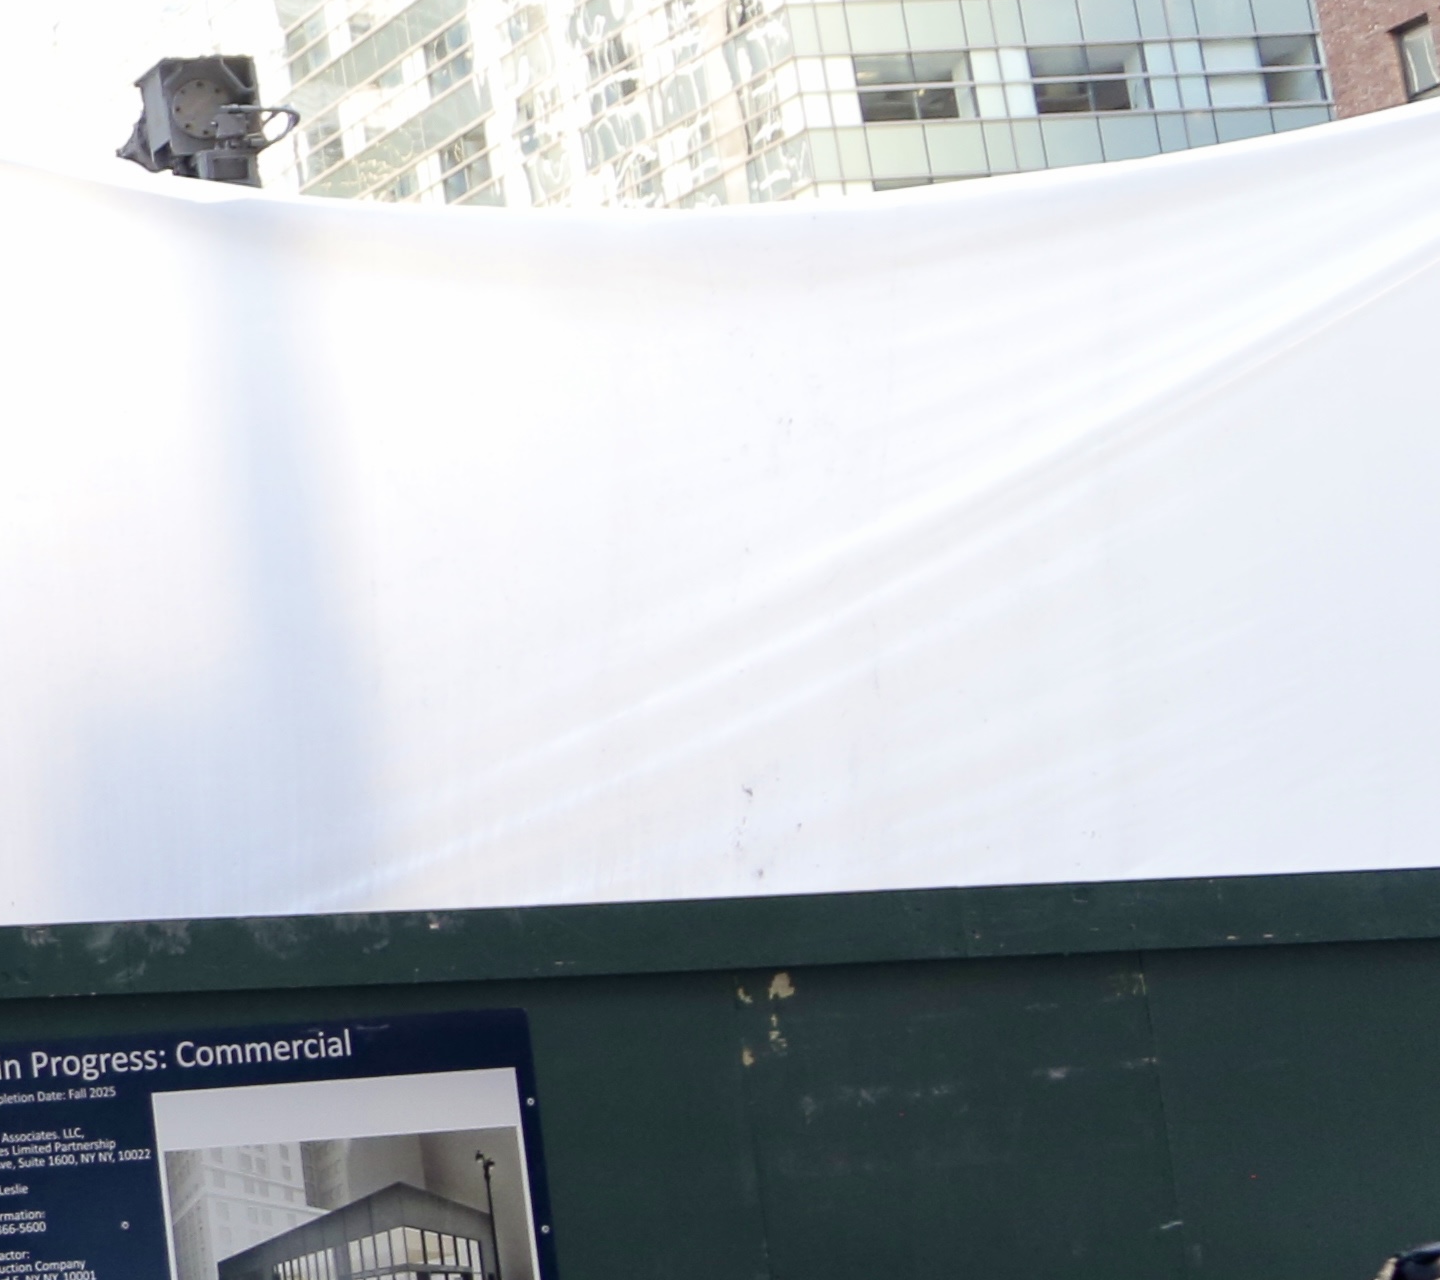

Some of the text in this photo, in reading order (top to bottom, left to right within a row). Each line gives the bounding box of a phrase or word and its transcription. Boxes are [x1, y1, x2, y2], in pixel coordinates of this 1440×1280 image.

[31, 1047, 168, 1080] Progress:
[176, 1029, 352, 1069] Commercial
[37, 1090, 66, 1102] Date:
[68, 1087, 87, 1100] Fall
[89, 1086, 117, 1098] 2025
[63, 1127, 85, 1139] LLC,
[12, 1143, 52, 1156] Limited
[54, 1139, 117, 1152] Partnership
[18, 1157, 46, 1168] Suite
[48, 1154, 79, 1167] 1600,
[80, 1152, 96, 1163] NY
[98, 1151, 116, 1163] NY,
[118, 1149, 152, 1162] 10022
[34, 1260, 86, 1272] Company
